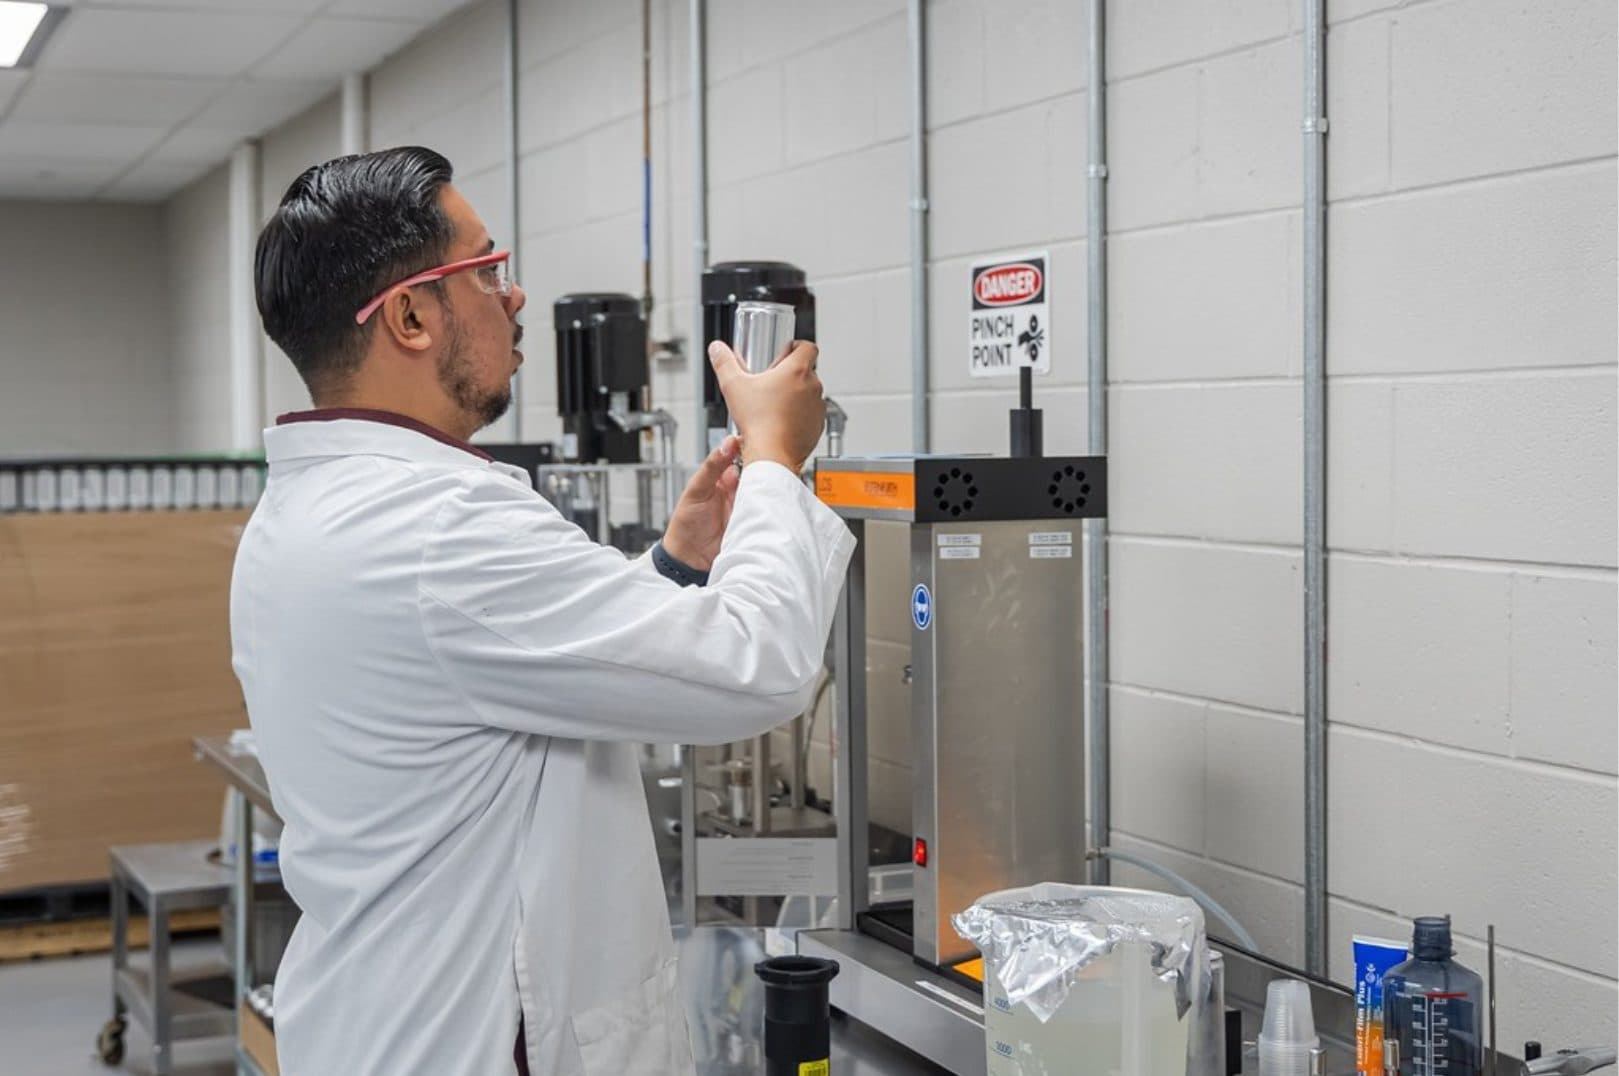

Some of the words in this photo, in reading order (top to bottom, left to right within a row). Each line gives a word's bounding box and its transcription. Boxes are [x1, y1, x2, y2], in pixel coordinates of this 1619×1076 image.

[981, 271, 1035, 299] DANGER
[972, 315, 1014, 340] PINCH
[972, 343, 1012, 368] POINT
[1357, 980, 1365, 1005] Plus
